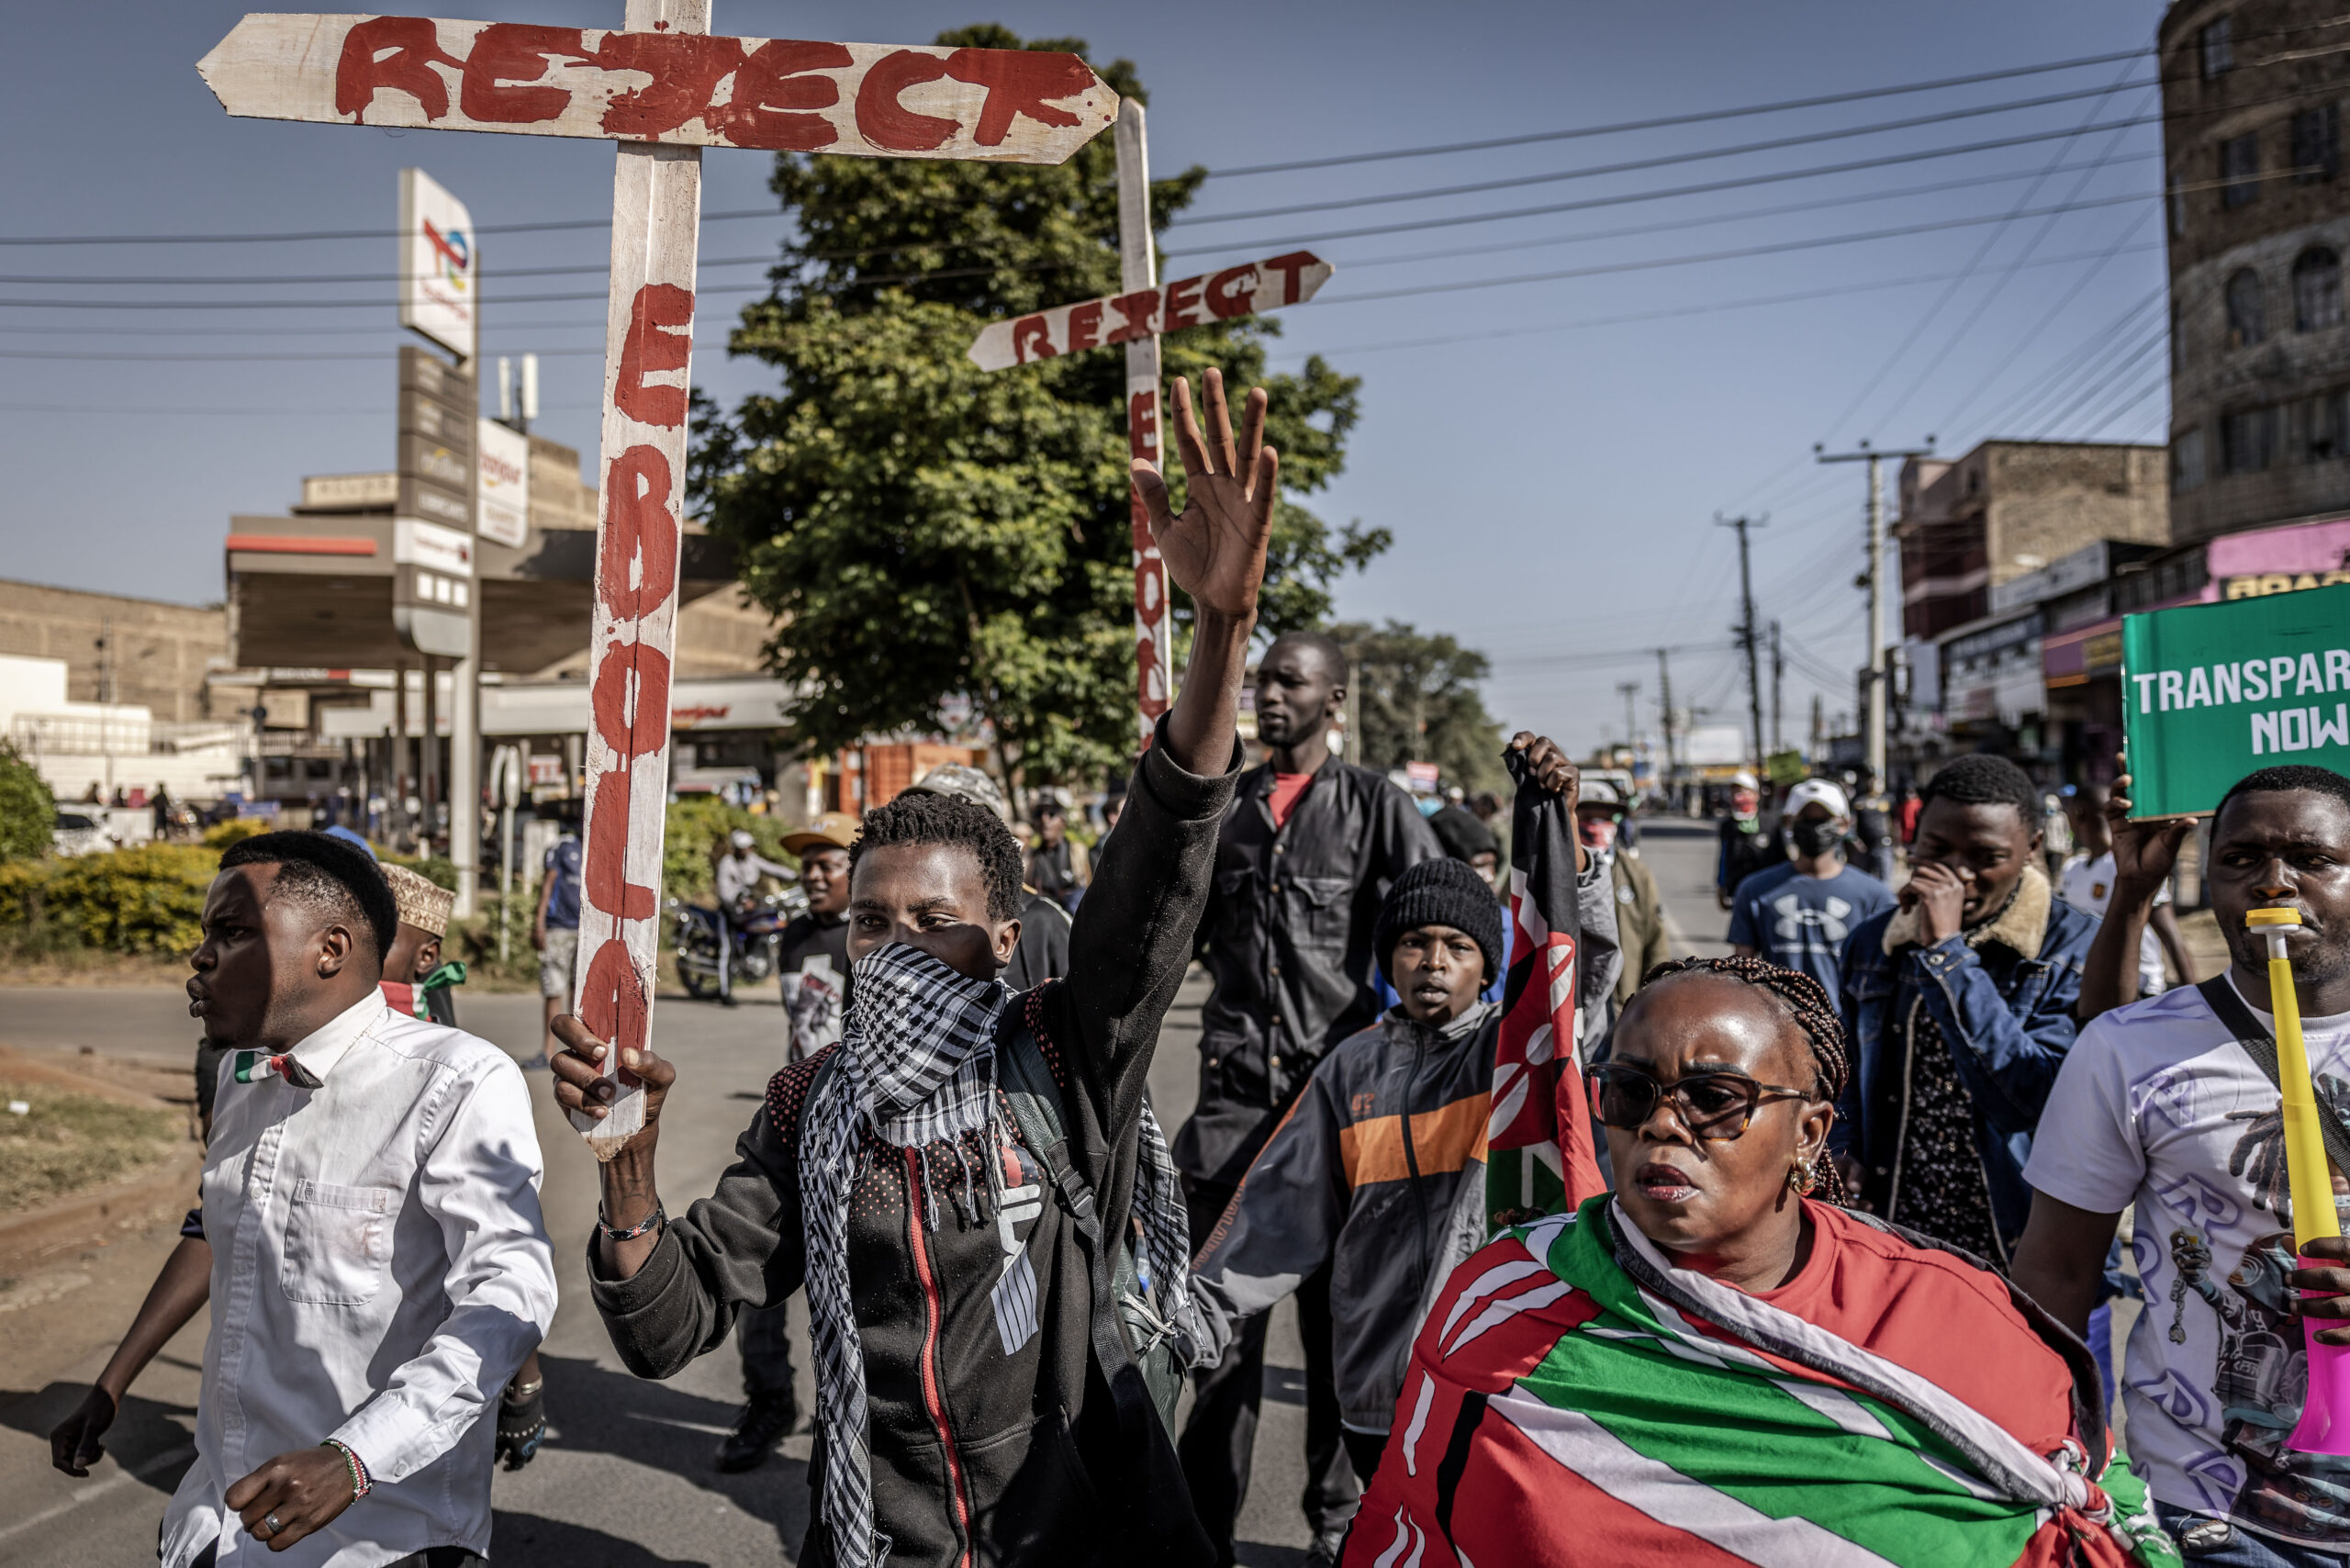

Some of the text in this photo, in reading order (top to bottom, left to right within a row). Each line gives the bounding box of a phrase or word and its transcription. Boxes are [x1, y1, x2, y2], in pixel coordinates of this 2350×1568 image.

[335, 16, 1098, 152] REJECT
[2132, 649, 2350, 714] TRANSPAR
[2251, 703, 2350, 756] NOW
